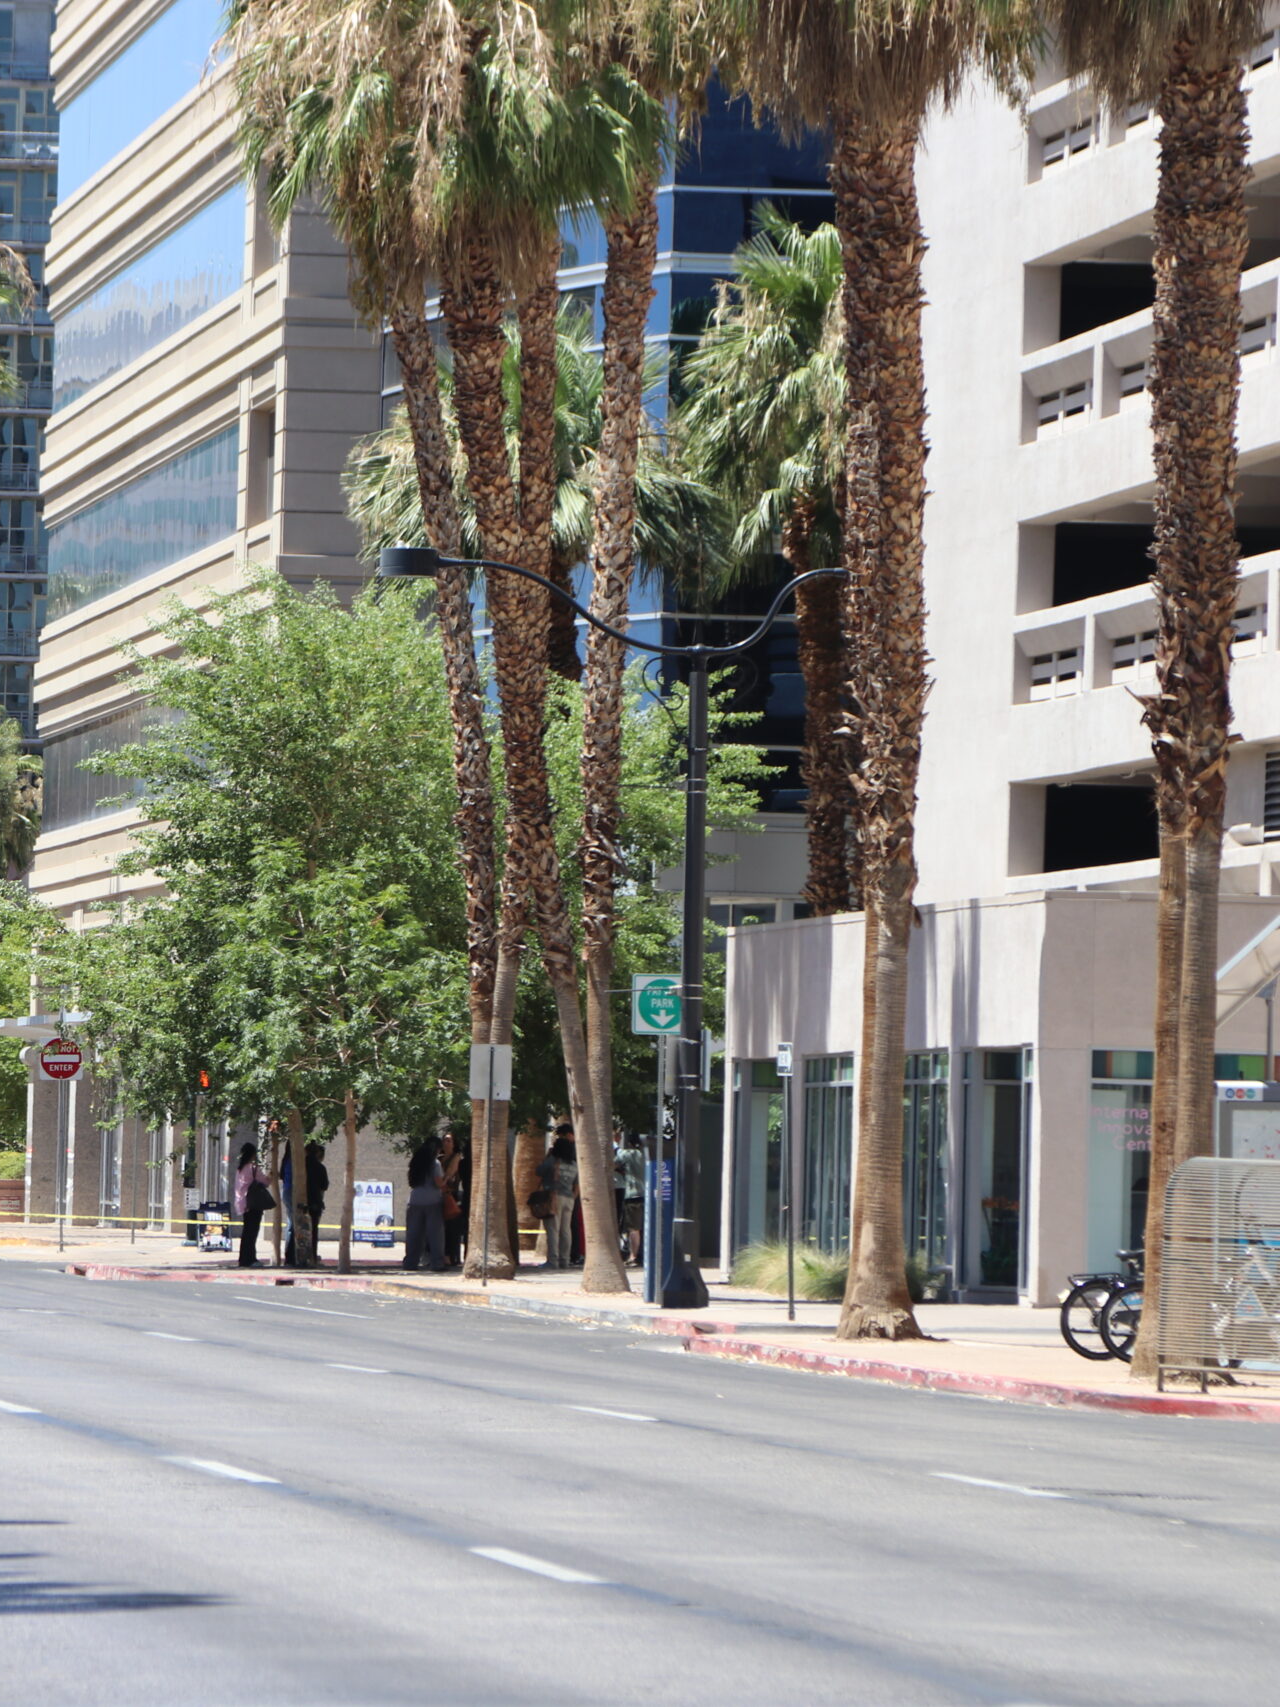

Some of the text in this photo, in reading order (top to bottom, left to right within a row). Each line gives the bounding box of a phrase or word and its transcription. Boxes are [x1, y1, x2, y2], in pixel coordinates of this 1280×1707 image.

[651, 998, 674, 1008] PARK
[60, 1044, 77, 1053] NOT
[49, 1064, 73, 1072] ENTER
[1088, 1106, 1149, 1119] Interna
[1097, 1120, 1153, 1135] Innova
[366, 1184, 391, 1194] AAA
